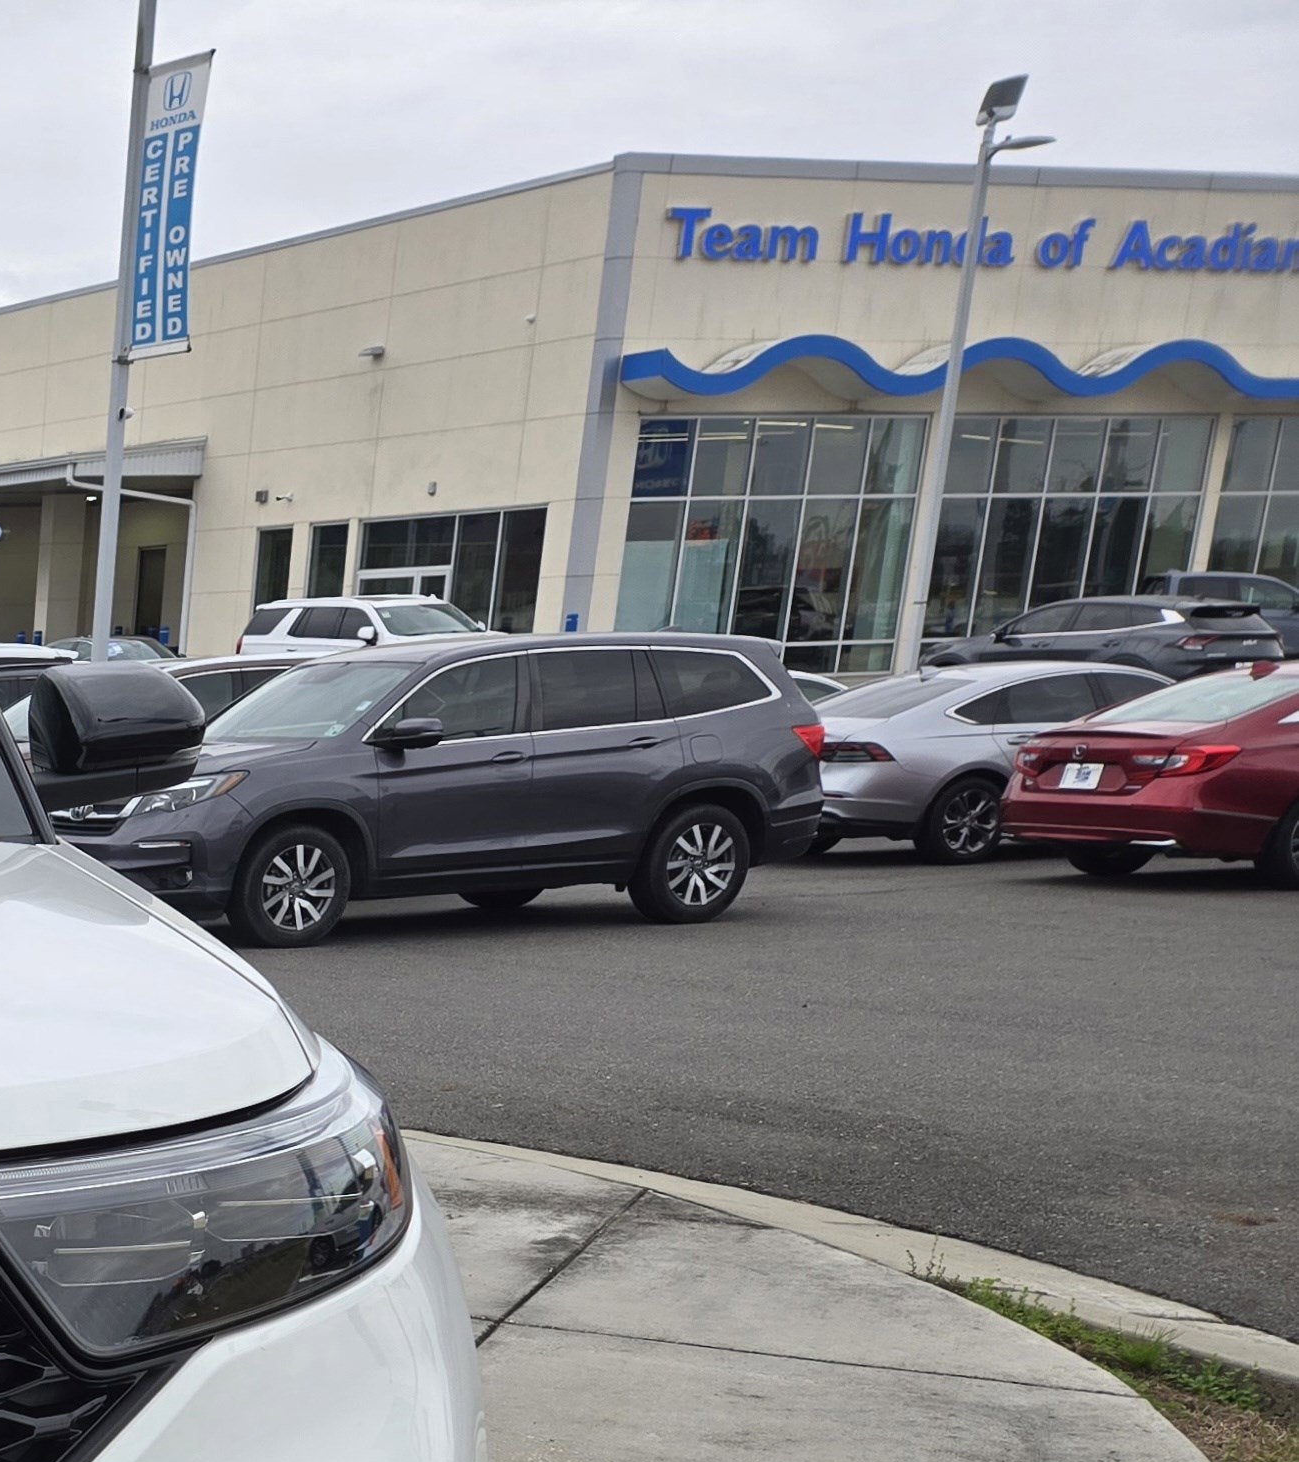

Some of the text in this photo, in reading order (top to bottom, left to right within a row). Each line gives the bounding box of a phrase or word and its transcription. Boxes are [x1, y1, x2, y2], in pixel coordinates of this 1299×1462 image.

[150, 110, 197, 131] HONDA
[135, 139, 164, 341] CERTIFIED
[165, 132, 194, 335] PRE OWNED
[667, 207, 820, 262] Team
[843, 212, 1015, 268] Honda
[1038, 218, 1097, 270] of
